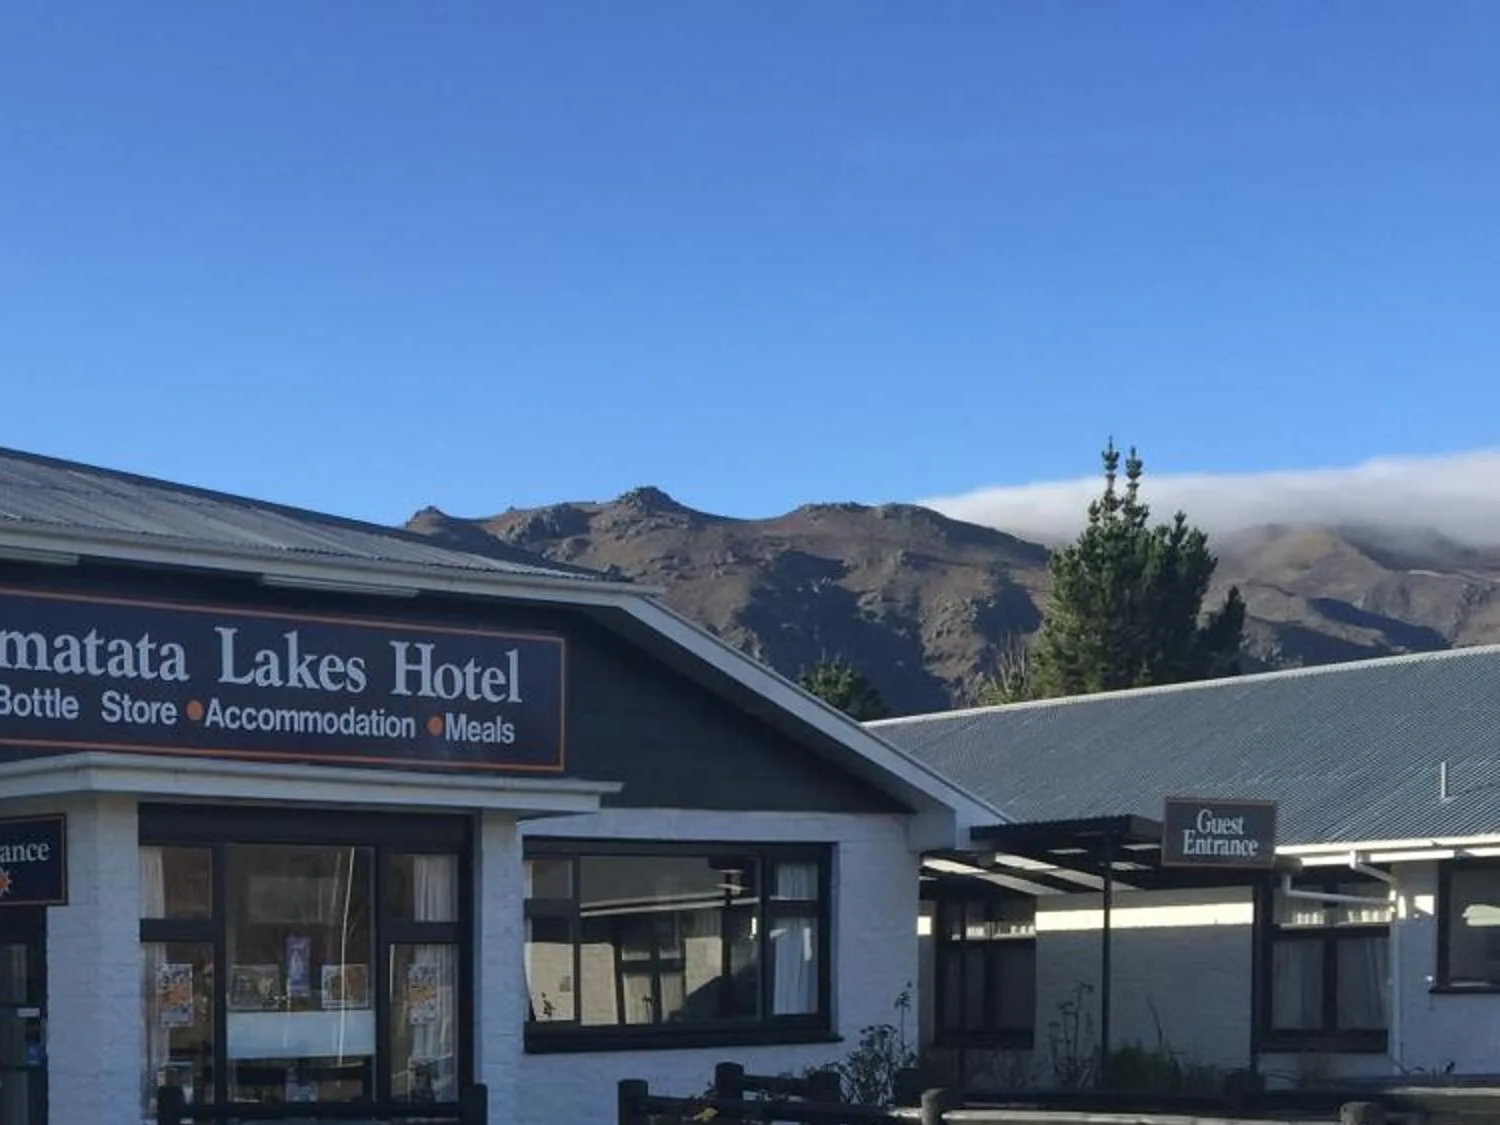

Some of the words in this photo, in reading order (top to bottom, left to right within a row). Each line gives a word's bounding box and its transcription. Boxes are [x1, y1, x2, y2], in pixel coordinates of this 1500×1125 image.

[214, 627, 367, 693] Lakes
[389, 640, 523, 703] Hotel
[100, 690, 178, 725] Store
[204, 698, 415, 738] Accommodation
[445, 712, 515, 745] Meals
[1182, 829, 1259, 856] Entrance
[1197, 809, 1244, 835] Guest
